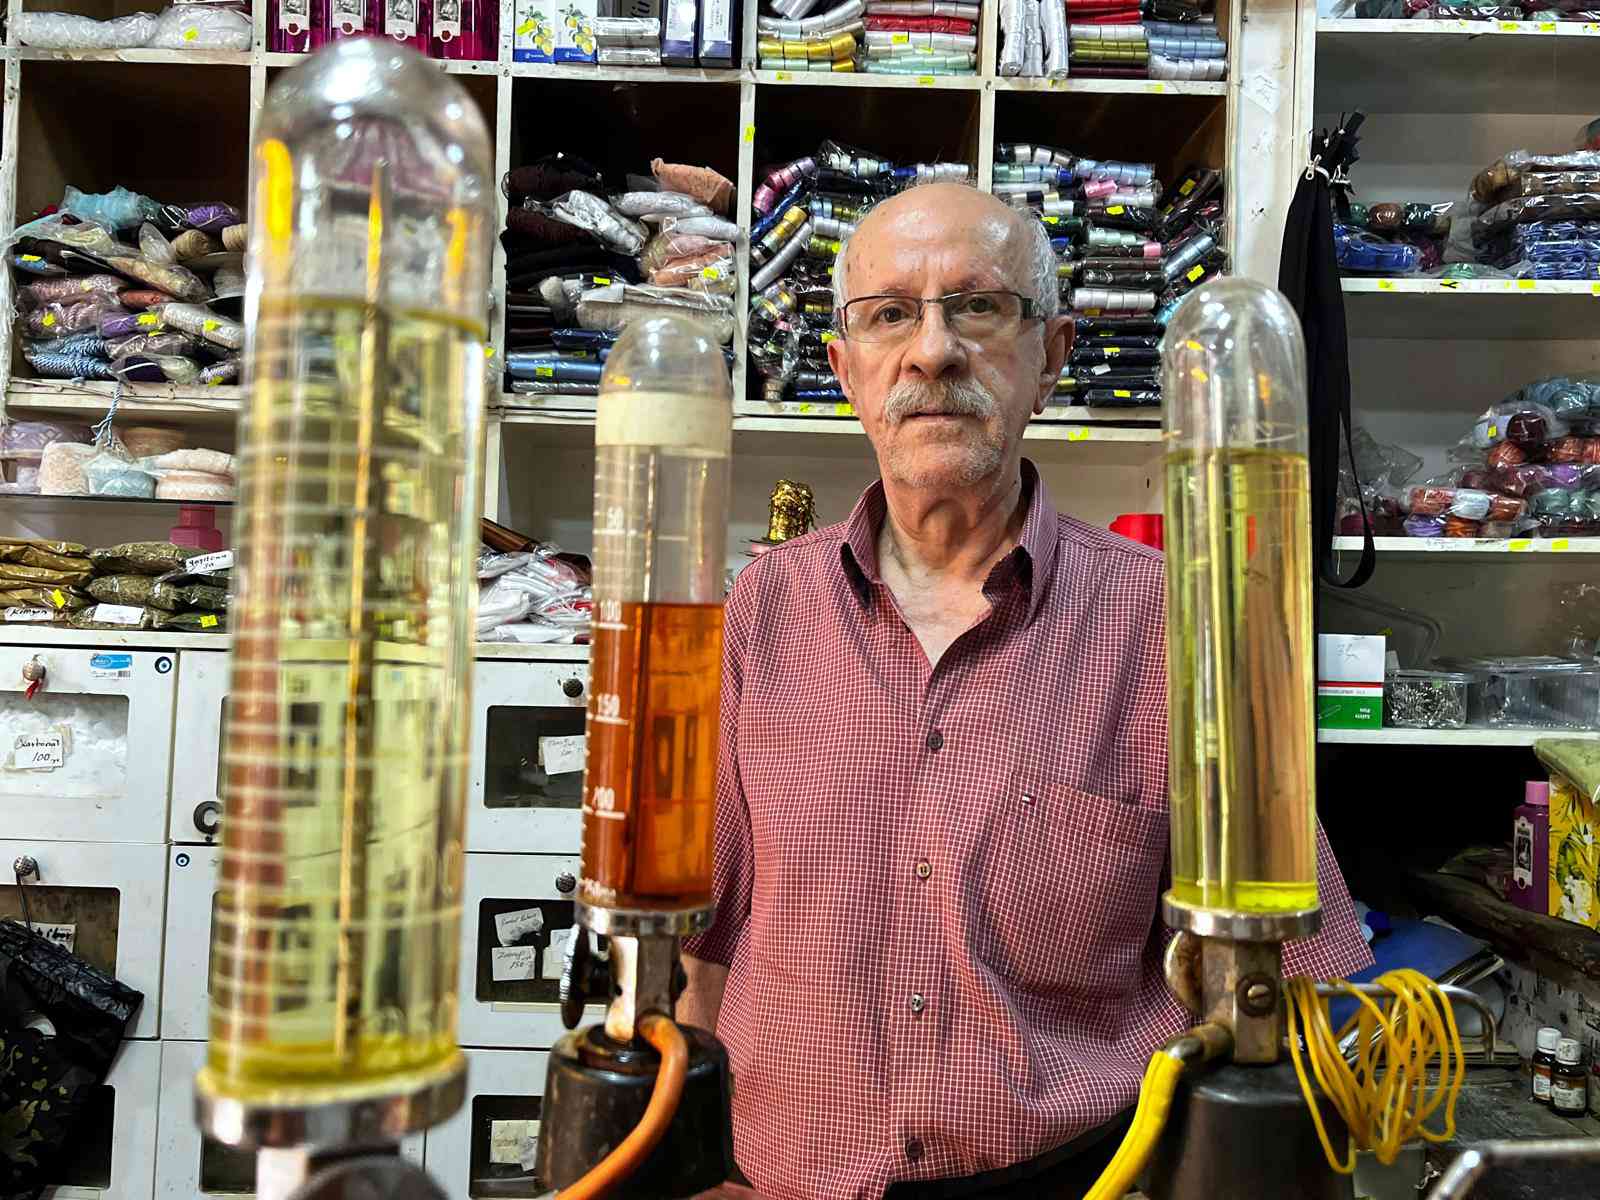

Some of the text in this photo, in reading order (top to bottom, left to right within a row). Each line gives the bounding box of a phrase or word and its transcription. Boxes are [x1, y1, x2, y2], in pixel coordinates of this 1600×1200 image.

[607, 507, 624, 529] 50
[600, 600, 622, 622] 100
[598, 694, 620, 719] 150
[32, 752, 50, 762] 100
